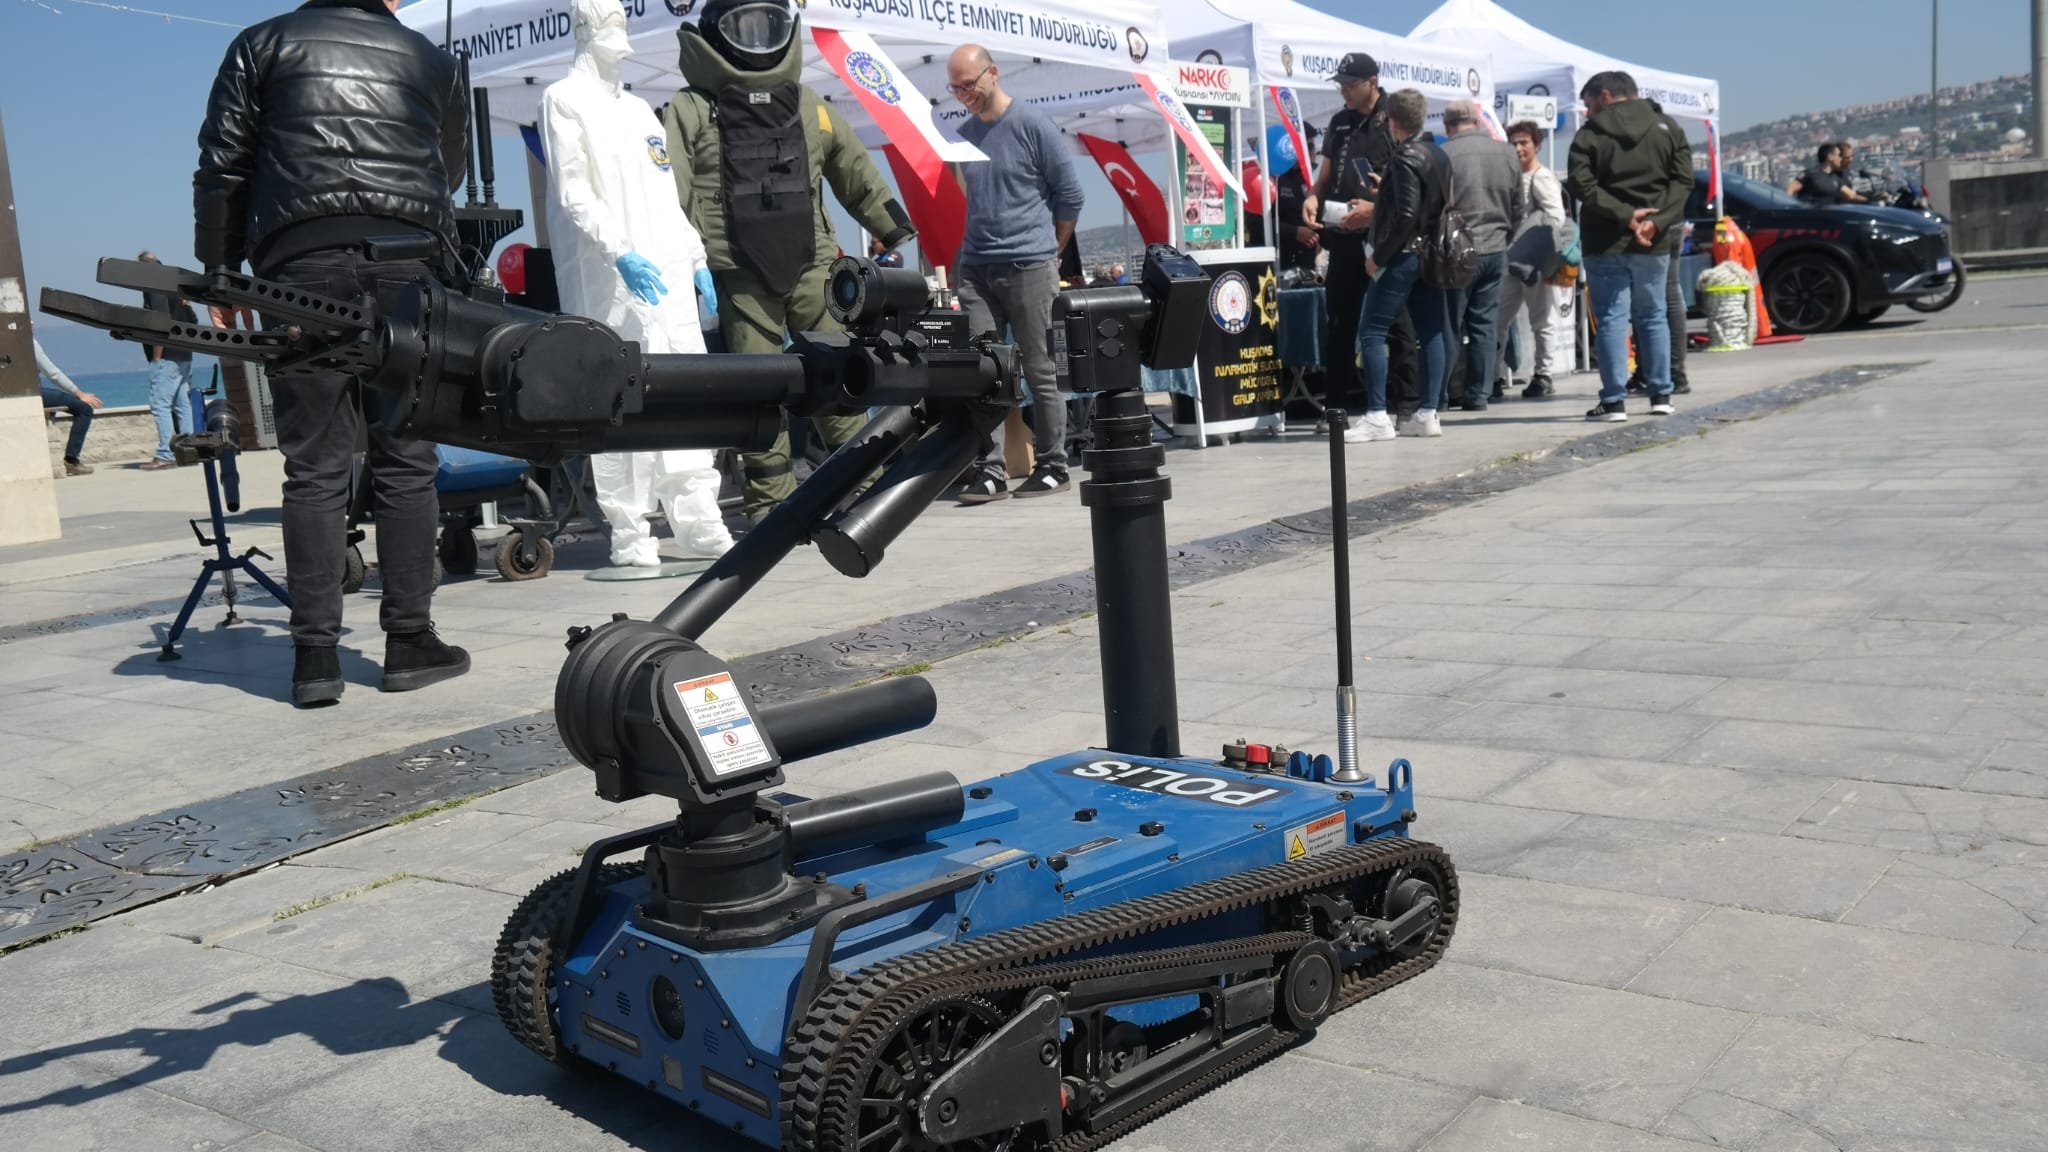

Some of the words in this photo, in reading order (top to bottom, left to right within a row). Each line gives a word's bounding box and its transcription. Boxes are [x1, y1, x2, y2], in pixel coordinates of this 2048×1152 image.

[960, 3, 1024, 36] EMNİYET
[1030, 12, 1119, 51] MÜDÜRLÜĞÜ
[1377, 58, 1409, 81] MNİYET
[1411, 61, 1462, 88] MÜDÜRLÜĞÜ
[1072, 760, 1280, 806] POLİS
